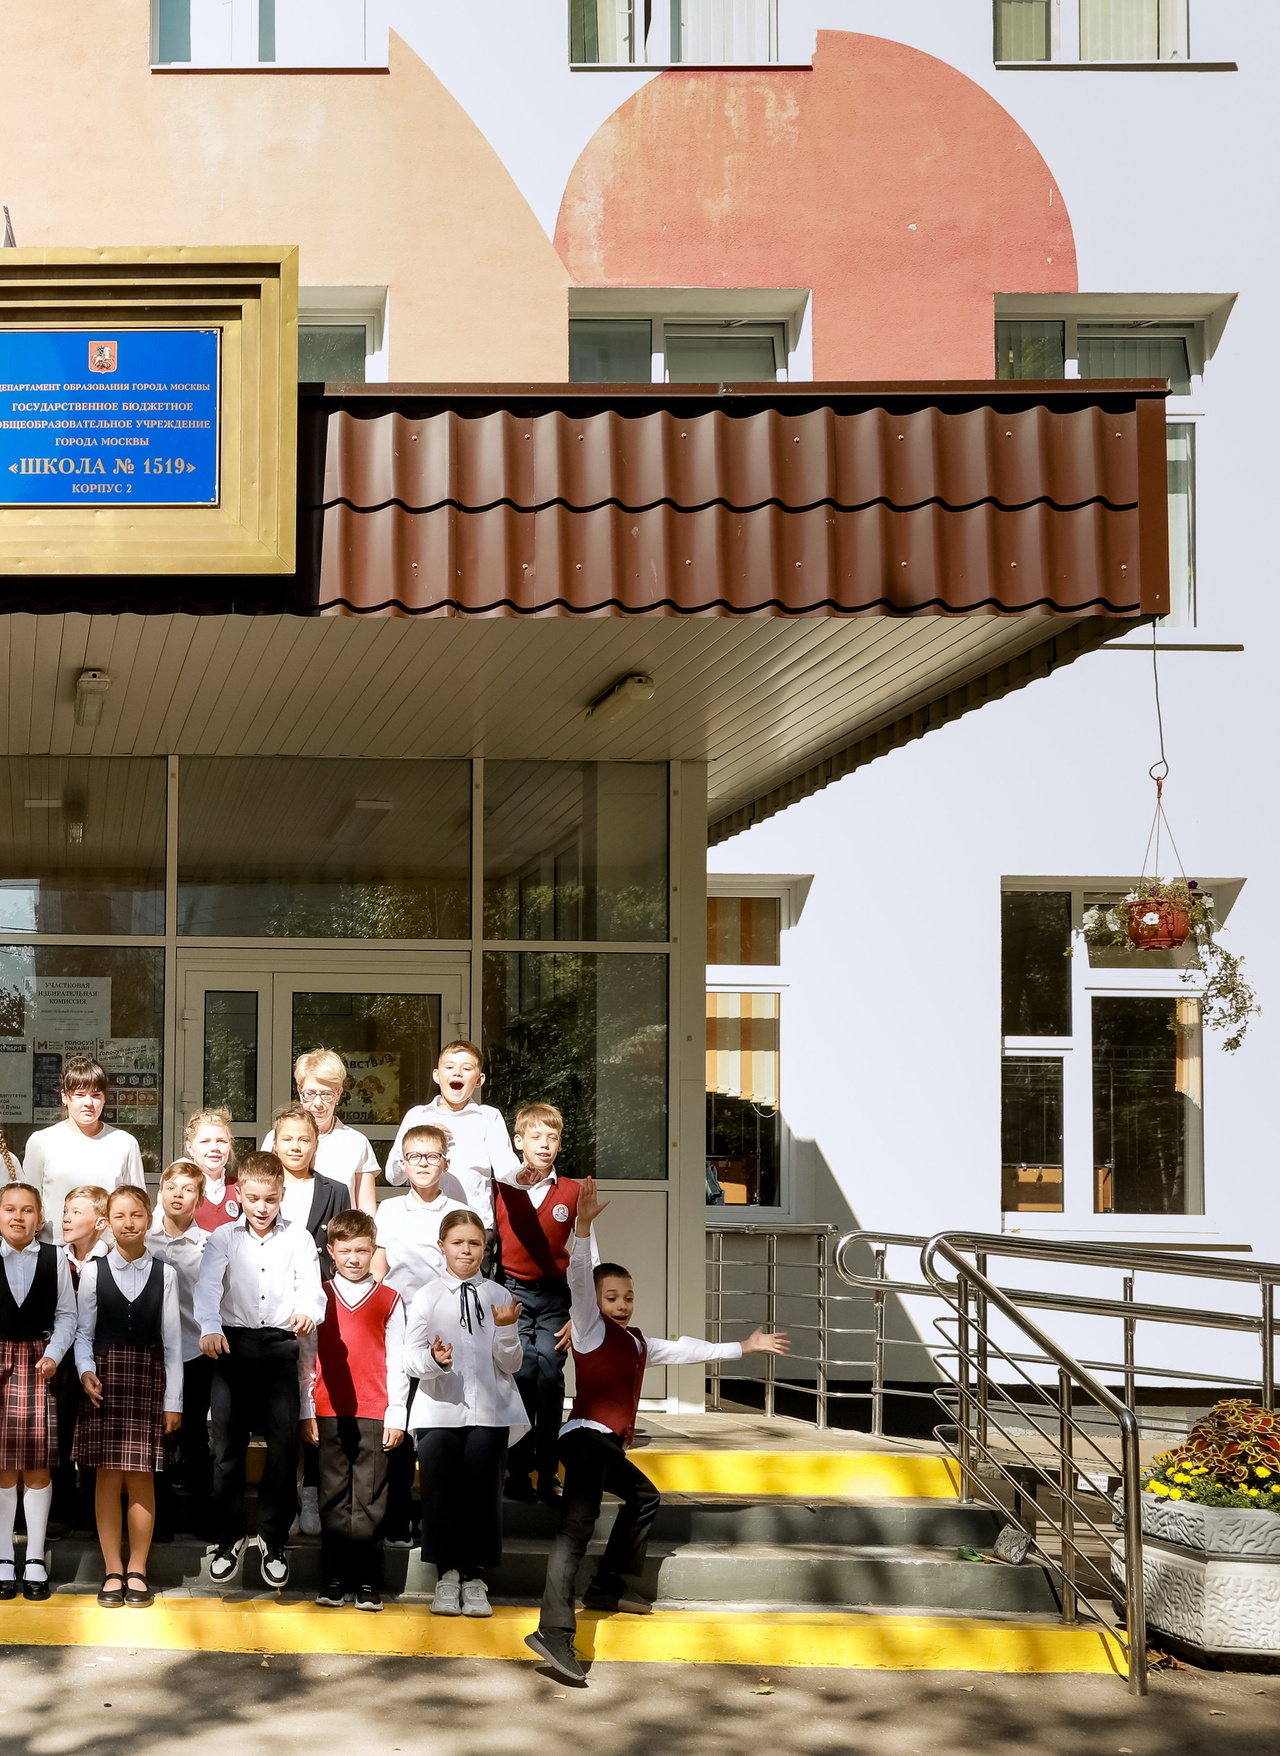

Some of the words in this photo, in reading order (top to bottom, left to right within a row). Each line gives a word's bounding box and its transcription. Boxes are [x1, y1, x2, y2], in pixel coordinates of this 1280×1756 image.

[63, 383, 130, 391] ОБРАЗОВАНИЯ
[132, 383, 168, 392] ГОРОДА
[170, 383, 210, 391] МОСКВЫ
[12, 402, 118, 413] ГОСУДАРСТВЕННОЕ
[122, 402, 193, 412] БЮДЖЕТНОЕ
[136, 420, 210, 430] УЧРЕЖДЕНИЕ
[55, 437, 98, 447] ГОРОДА
[101, 437, 149, 446] МОСКВЫ
[8, 458, 106, 474] «ШКОЛА
[113, 458, 135, 474] №
[143, 458, 196, 474] 1519»
[72, 484, 123, 493] КОРПУС
[126, 484, 132, 493] 2
